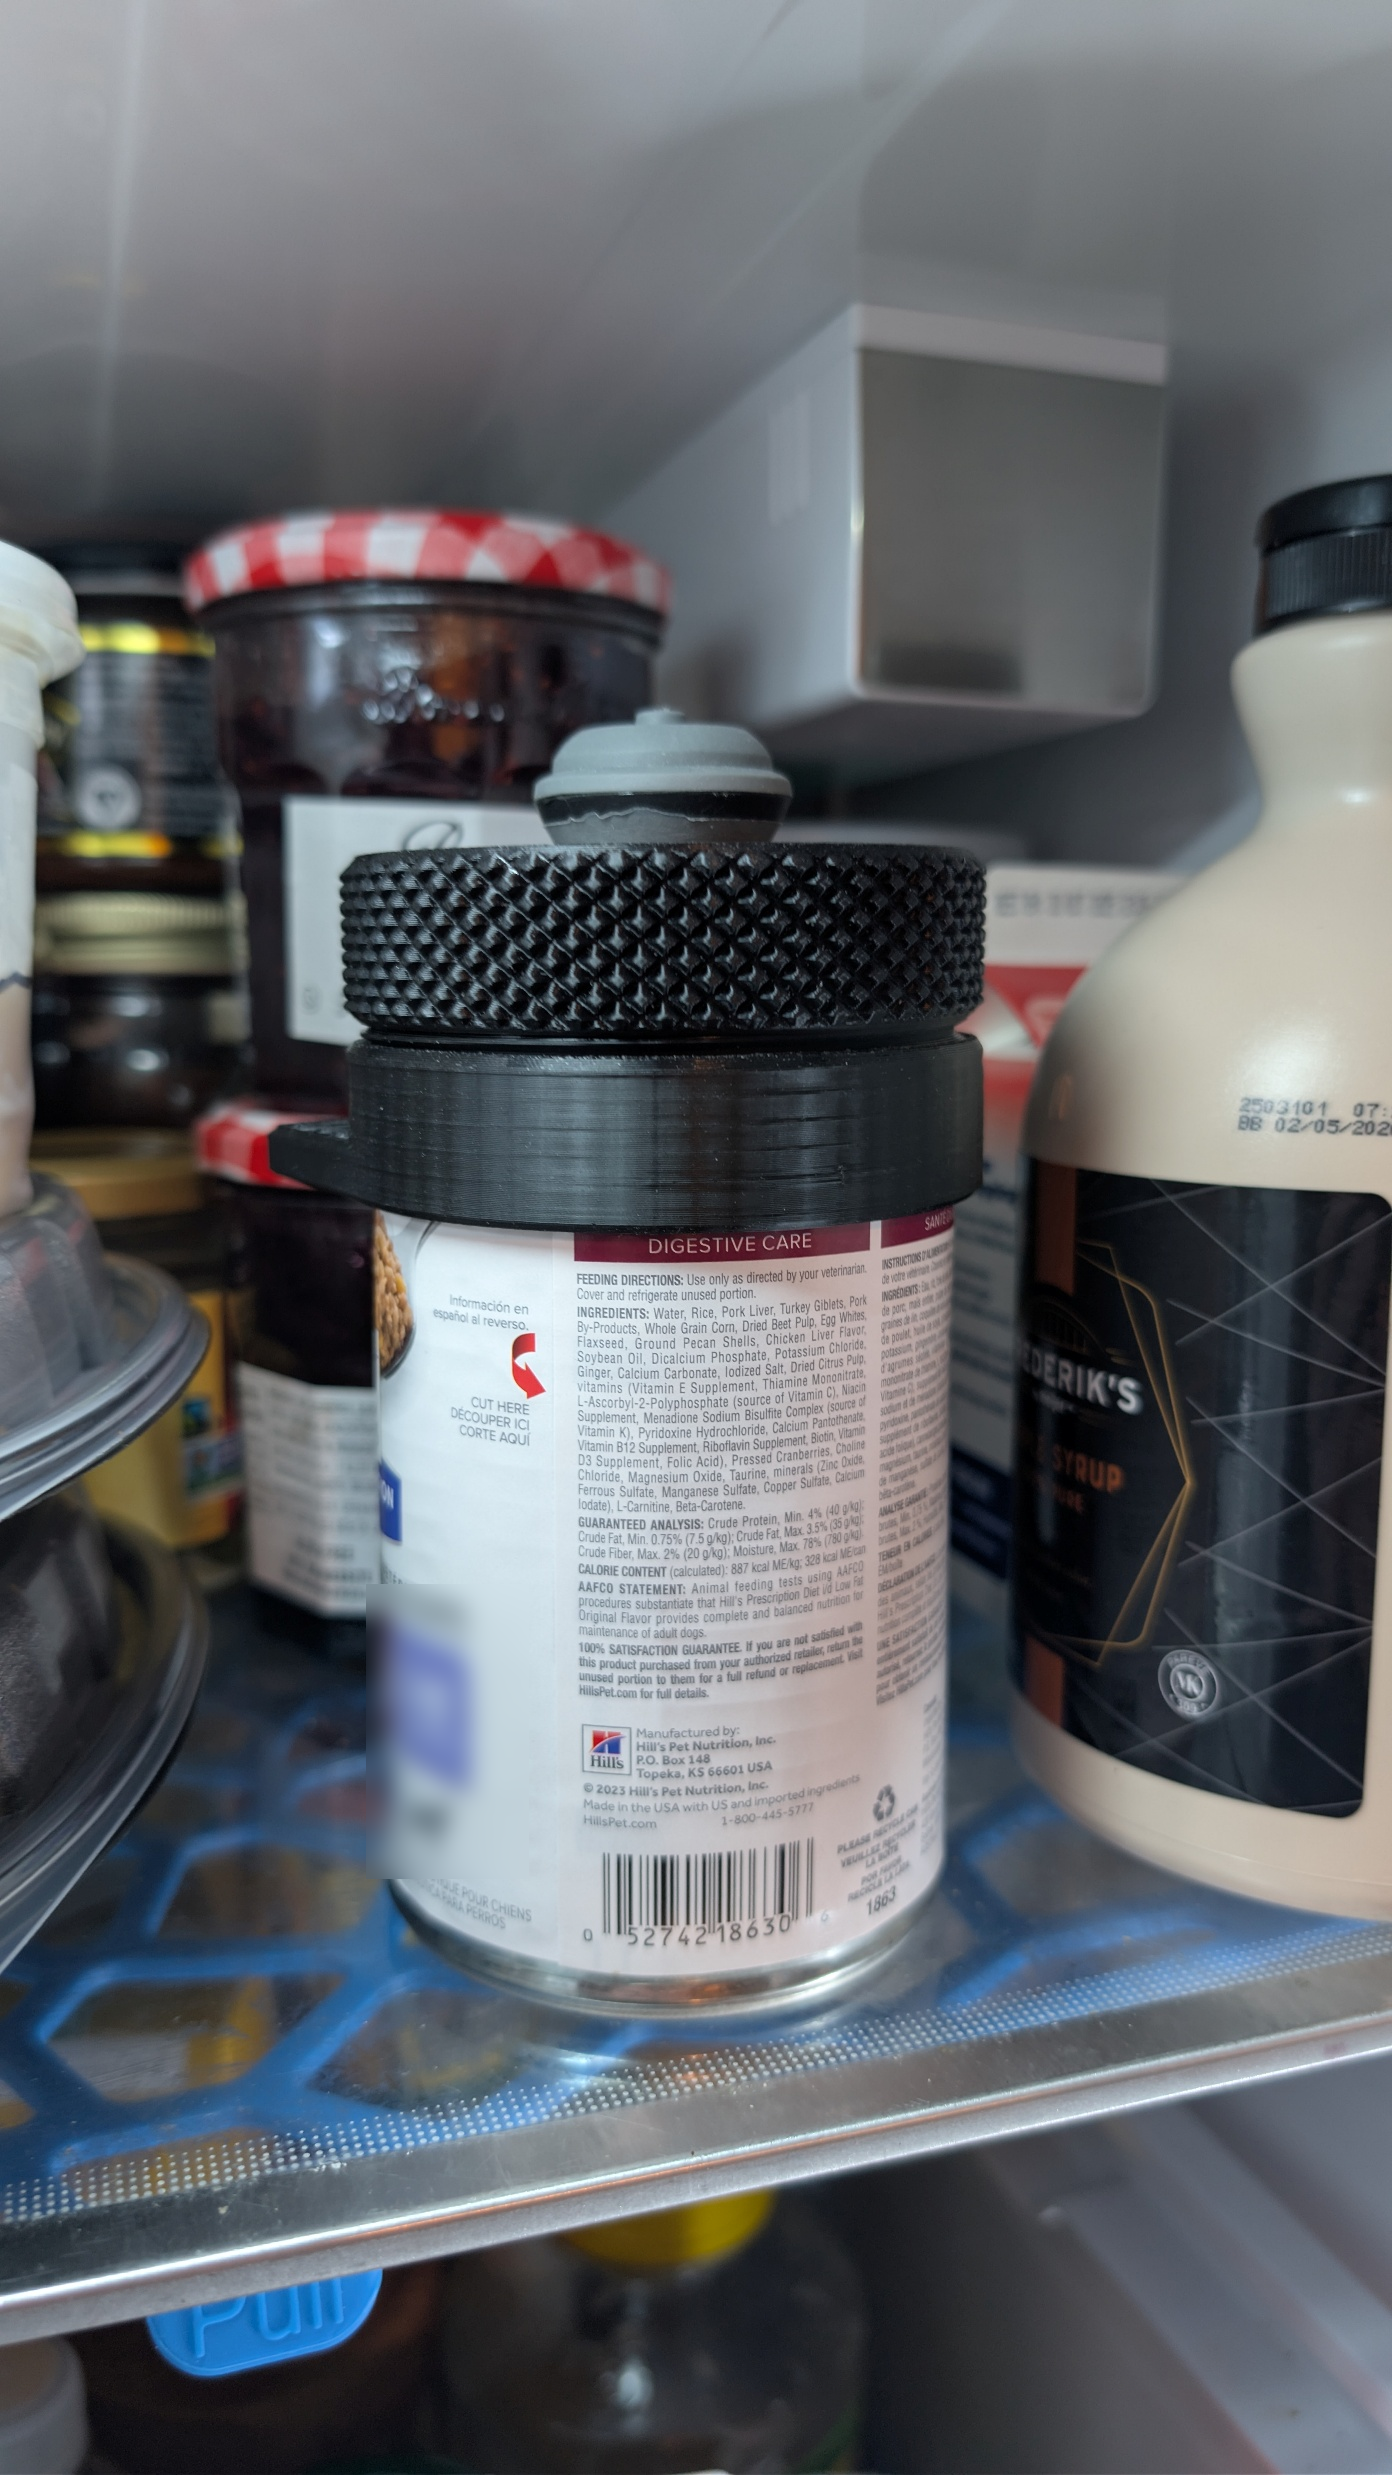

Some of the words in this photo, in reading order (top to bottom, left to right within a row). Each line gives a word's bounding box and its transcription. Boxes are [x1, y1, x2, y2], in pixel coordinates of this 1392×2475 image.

[1240, 1097, 1328, 1116] 2503101
[1353, 1103, 1392, 1117] 07:
[648, 1236, 756, 1254] DIGESTIVE
[762, 1232, 812, 1251] CARE
[576, 1272, 618, 1286] FEEDING
[620, 1273, 684, 1286] DIRECTIONS:
[686, 1273, 706, 1286] Use
[708, 1272, 730, 1287] only
[731, 1273, 744, 1285] as
[746, 1269, 783, 1284] directed
[785, 1268, 797, 1284] by
[798, 1269, 819, 1283] your
[820, 1262, 867, 1278] veterinarian.
[449, 1294, 511, 1314] Información
[513, 1304, 529, 1315] en
[576, 1286, 605, 1301] Cover
[606, 1288, 625, 1301] and
[627, 1288, 678, 1304] refrigerate
[680, 1288, 717, 1301] unused
[719, 1286, 756, 1302] portion.
[576, 1306, 649, 1319] INGREDIENTS:
[652, 1307, 687, 1321] Water,
[691, 1306, 717, 1320] Rice,
[721, 1304, 746, 1318] Pork
[749, 1304, 776, 1317] Liver,
[779, 1301, 811, 1315] Turkey
[813, 1298, 846, 1312] Giblets,
[849, 1293, 867, 1308] Pork
[433, 1308, 469, 1323] español
[471, 1314, 480, 1325] al
[483, 1316, 529, 1331] reverso.
[576, 1320, 640, 1336] By-Products,
[643, 1321, 676, 1335] Whole
[680, 1321, 707, 1335] Grain
[711, 1320, 738, 1334] Corn,
[741, 1318, 767, 1332] Dried
[771, 1317, 792, 1331] Beet
[794, 1315, 817, 1330] Pulp,
[820, 1313, 836, 1328] Egg
[838, 1310, 867, 1323] Whites,
[576, 1334, 628, 1350] Flaxseed,
[634, 1336, 676, 1350] Ground
[682, 1336, 716, 1349] Pecan
[722, 1334, 759, 1348] Shells,
[765, 1332, 806, 1346] Chicken
[810, 1329, 835, 1342] Liver
[839, 1325, 867, 1338] Flavor,
[576, 1350, 623, 1366] Soybean
[627, 1351, 646, 1366] Oil,
[651, 1351, 706, 1365] Dicalcium
[710, 1349, 770, 1364] Phosphate,
[774, 1344, 825, 1359] Potassium
[828, 1338, 867, 1354] Chloride,
[471, 1396, 494, 1411] CUT
[497, 1400, 530, 1416] HERE
[577, 1395, 729, 1411] L-Ascorbyl-2-Polyphosphate
[732, 1394, 771, 1410] (source
[774, 1391, 785, 1404] of
[787, 1388, 823, 1403] Vitamin
[450, 1405, 511, 1429] DÉCOUPER
[514, 1417, 530, 1431] ICI
[459, 1424, 497, 1442] CORTE
[499, 1432, 532, 1447] AQUÍ
[1052, 1442, 1127, 1495] SYRUP
[577, 1497, 614, 1514] Iodate),
[616, 1499, 673, 1514] L-Carnitine,
[675, 1499, 745, 1512] Beta-Carotene.
[577, 1516, 646, 1530] GUARANTEED
[649, 1518, 704, 1531] ANALYSIS:
[707, 1516, 738, 1529] Crude
[741, 1513, 780, 1527] Protein,
[783, 1510, 804, 1523] Min.
[577, 1562, 619, 1577] CALORIE
[620, 1565, 667, 1578] CONTENT
[669, 1563, 728, 1579] (calculated):
[730, 1561, 749, 1575] 887
[751, 1560, 770, 1573] kcal
[577, 1580, 614, 1594] AAFCO
[618, 1582, 686, 1595] STATEMENT:
[690, 1581, 729, 1594] Animal
[734, 1578, 773, 1592] feeding
[578, 1641, 605, 1654] 100%
[608, 1643, 678, 1656] SATISFACTION
[681, 1641, 741, 1656] GUARANTEE.
[578, 1684, 638, 1699] HillsPet.com
[639, 1687, 654, 1700] for
[655, 1687, 672, 1700] full
[673, 1687, 709, 1699] details.
[636, 1725, 720, 1739] Manufactured
[722, 1725, 740, 1738] by:
[636, 1741, 666, 1752] Hill's
[669, 1741, 689, 1752] Pet
[692, 1738, 753, 1751] Nutrition,
[755, 1735, 777, 1746] Inc.
[590, 1754, 624, 1769] Hill's
[636, 1755, 659, 1765] P.O.
[662, 1755, 685, 1765] Box
[688, 1753, 711, 1765] 148
[635, 1767, 685, 1781] Topeka,
[688, 1767, 705, 1778] KS
[708, 1764, 744, 1777] 66601
[747, 1760, 773, 1773] USA
[583, 1799, 616, 1811] Made
[618, 1801, 629, 1812] in
[631, 1801, 652, 1813] the
[654, 1802, 681, 1813] USA
[682, 1801, 709, 1812] with
[711, 1799, 729, 1811] US
[730, 1797, 753, 1809] and
[754, 1788, 805, 1807] imported
[807, 1774, 861, 1797] ingredients
[596, 1784, 626, 1796] 2023
[628, 1785, 659, 1797] Hill's
[661, 1786, 682, 1797] Pet
[685, 1783, 745, 1796] Nutrition,
[748, 1780, 769, 1791] Inc.
[582, 1815, 657, 1829] HillsPet.com
[722, 1802, 815, 1826] 1-800-445-5777
[837, 1832, 871, 1855] PLEASE
[840, 1843, 881, 1868] VEUILLEZ
[865, 1856, 876, 1869] LA
[491, 1898, 532, 1922] CHIENS
[867, 1885, 896, 1915] 1863
[466, 1903, 506, 1929] PERROS
[583, 1928, 593, 1942] 0
[627, 1926, 707, 1947] 52742
[717, 1914, 791, 1943] 18630
